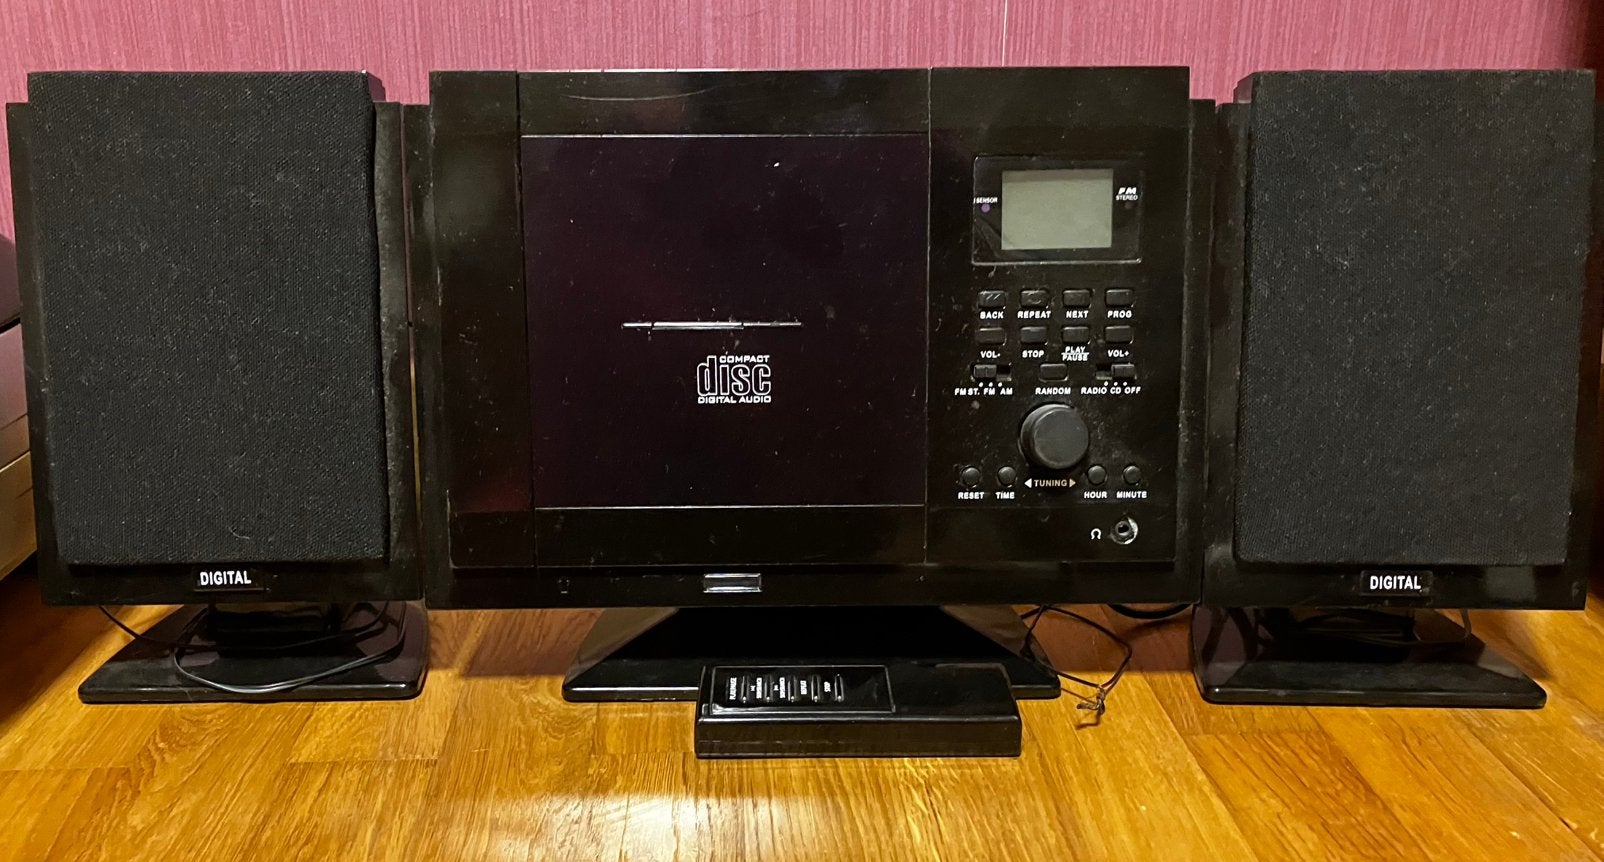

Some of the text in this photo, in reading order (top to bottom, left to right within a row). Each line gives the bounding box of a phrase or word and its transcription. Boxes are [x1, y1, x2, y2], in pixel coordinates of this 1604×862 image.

[979, 311, 1004, 319] BACK
[1017, 311, 1051, 319] REPEAT
[1066, 311, 1089, 319] NEXT
[719, 355, 770, 363] COMPACT
[1062, 354, 1088, 362] PAUSE
[696, 355, 771, 396] disc
[954, 387, 1013, 396] FM ST. FM AM
[1080, 387, 1142, 395] RADIO CD OFF
[697, 396, 772, 404] DIGITAL AUDIO
[1033, 479, 1068, 487] TUNING
[957, 491, 985, 499] RESET
[995, 491, 1015, 499] TIME
[1083, 491, 1108, 499] HOUR
[1116, 490, 1148, 498] MINUTE
[199, 570, 252, 586] DIGITAL
[1369, 575, 1422, 590] DIGITAL
